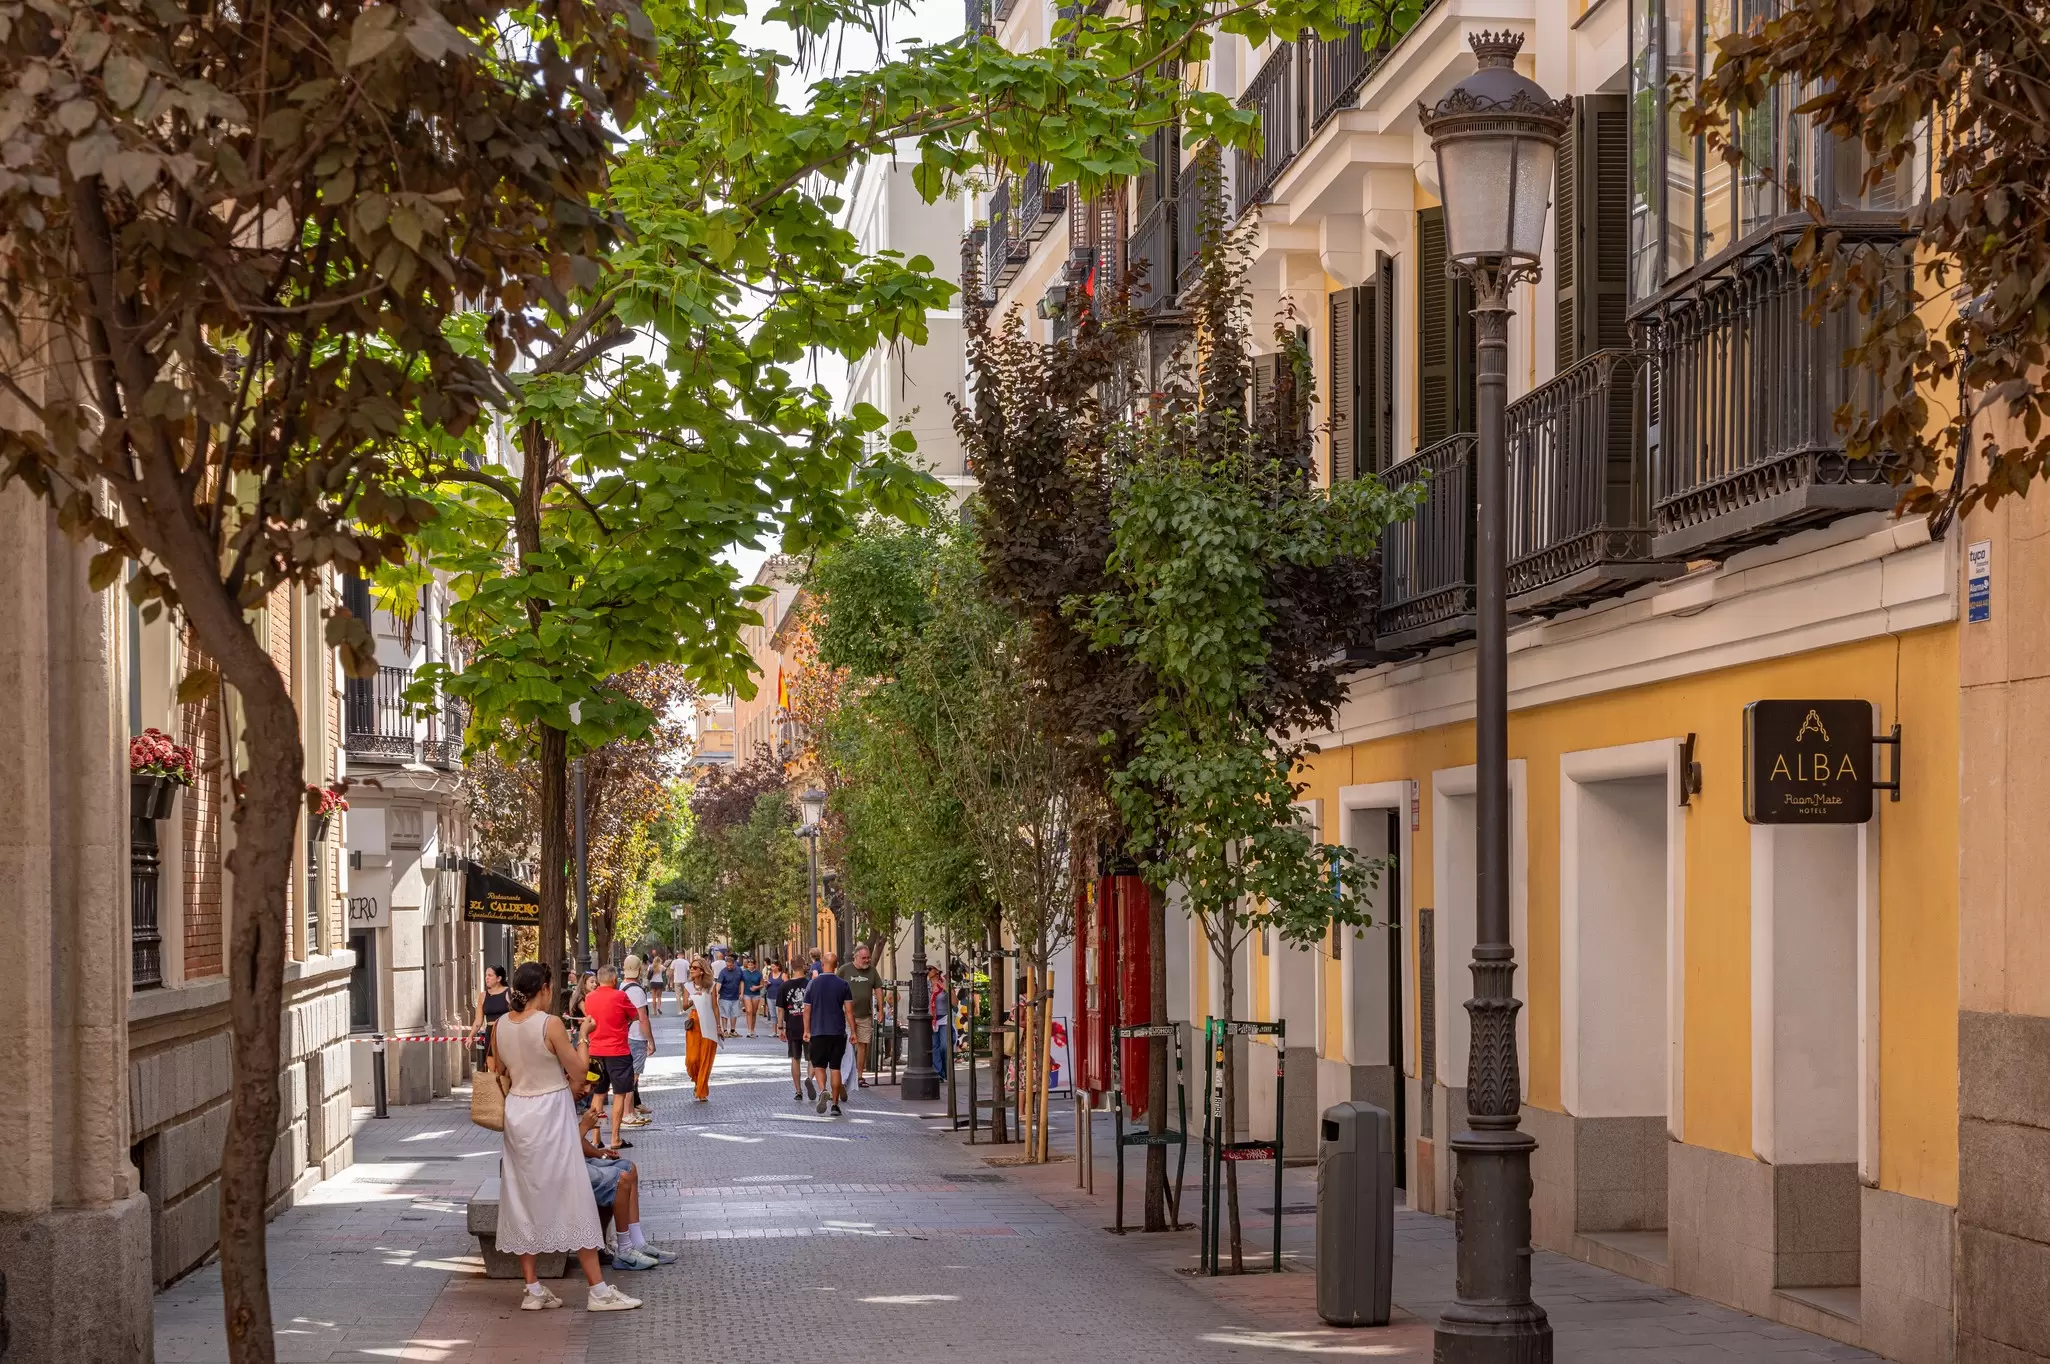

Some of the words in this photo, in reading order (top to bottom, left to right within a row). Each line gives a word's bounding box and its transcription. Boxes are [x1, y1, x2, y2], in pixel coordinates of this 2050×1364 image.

[1969, 550, 1986, 564] tyco
[1769, 753, 1858, 781] ALBA
[1784, 794, 1814, 806] Room
[1813, 793, 1843, 806] Mate
[487, 892, 521, 900] Restaurante
[469, 900, 485, 910] EL
[490, 901, 539, 917] CALDERO
